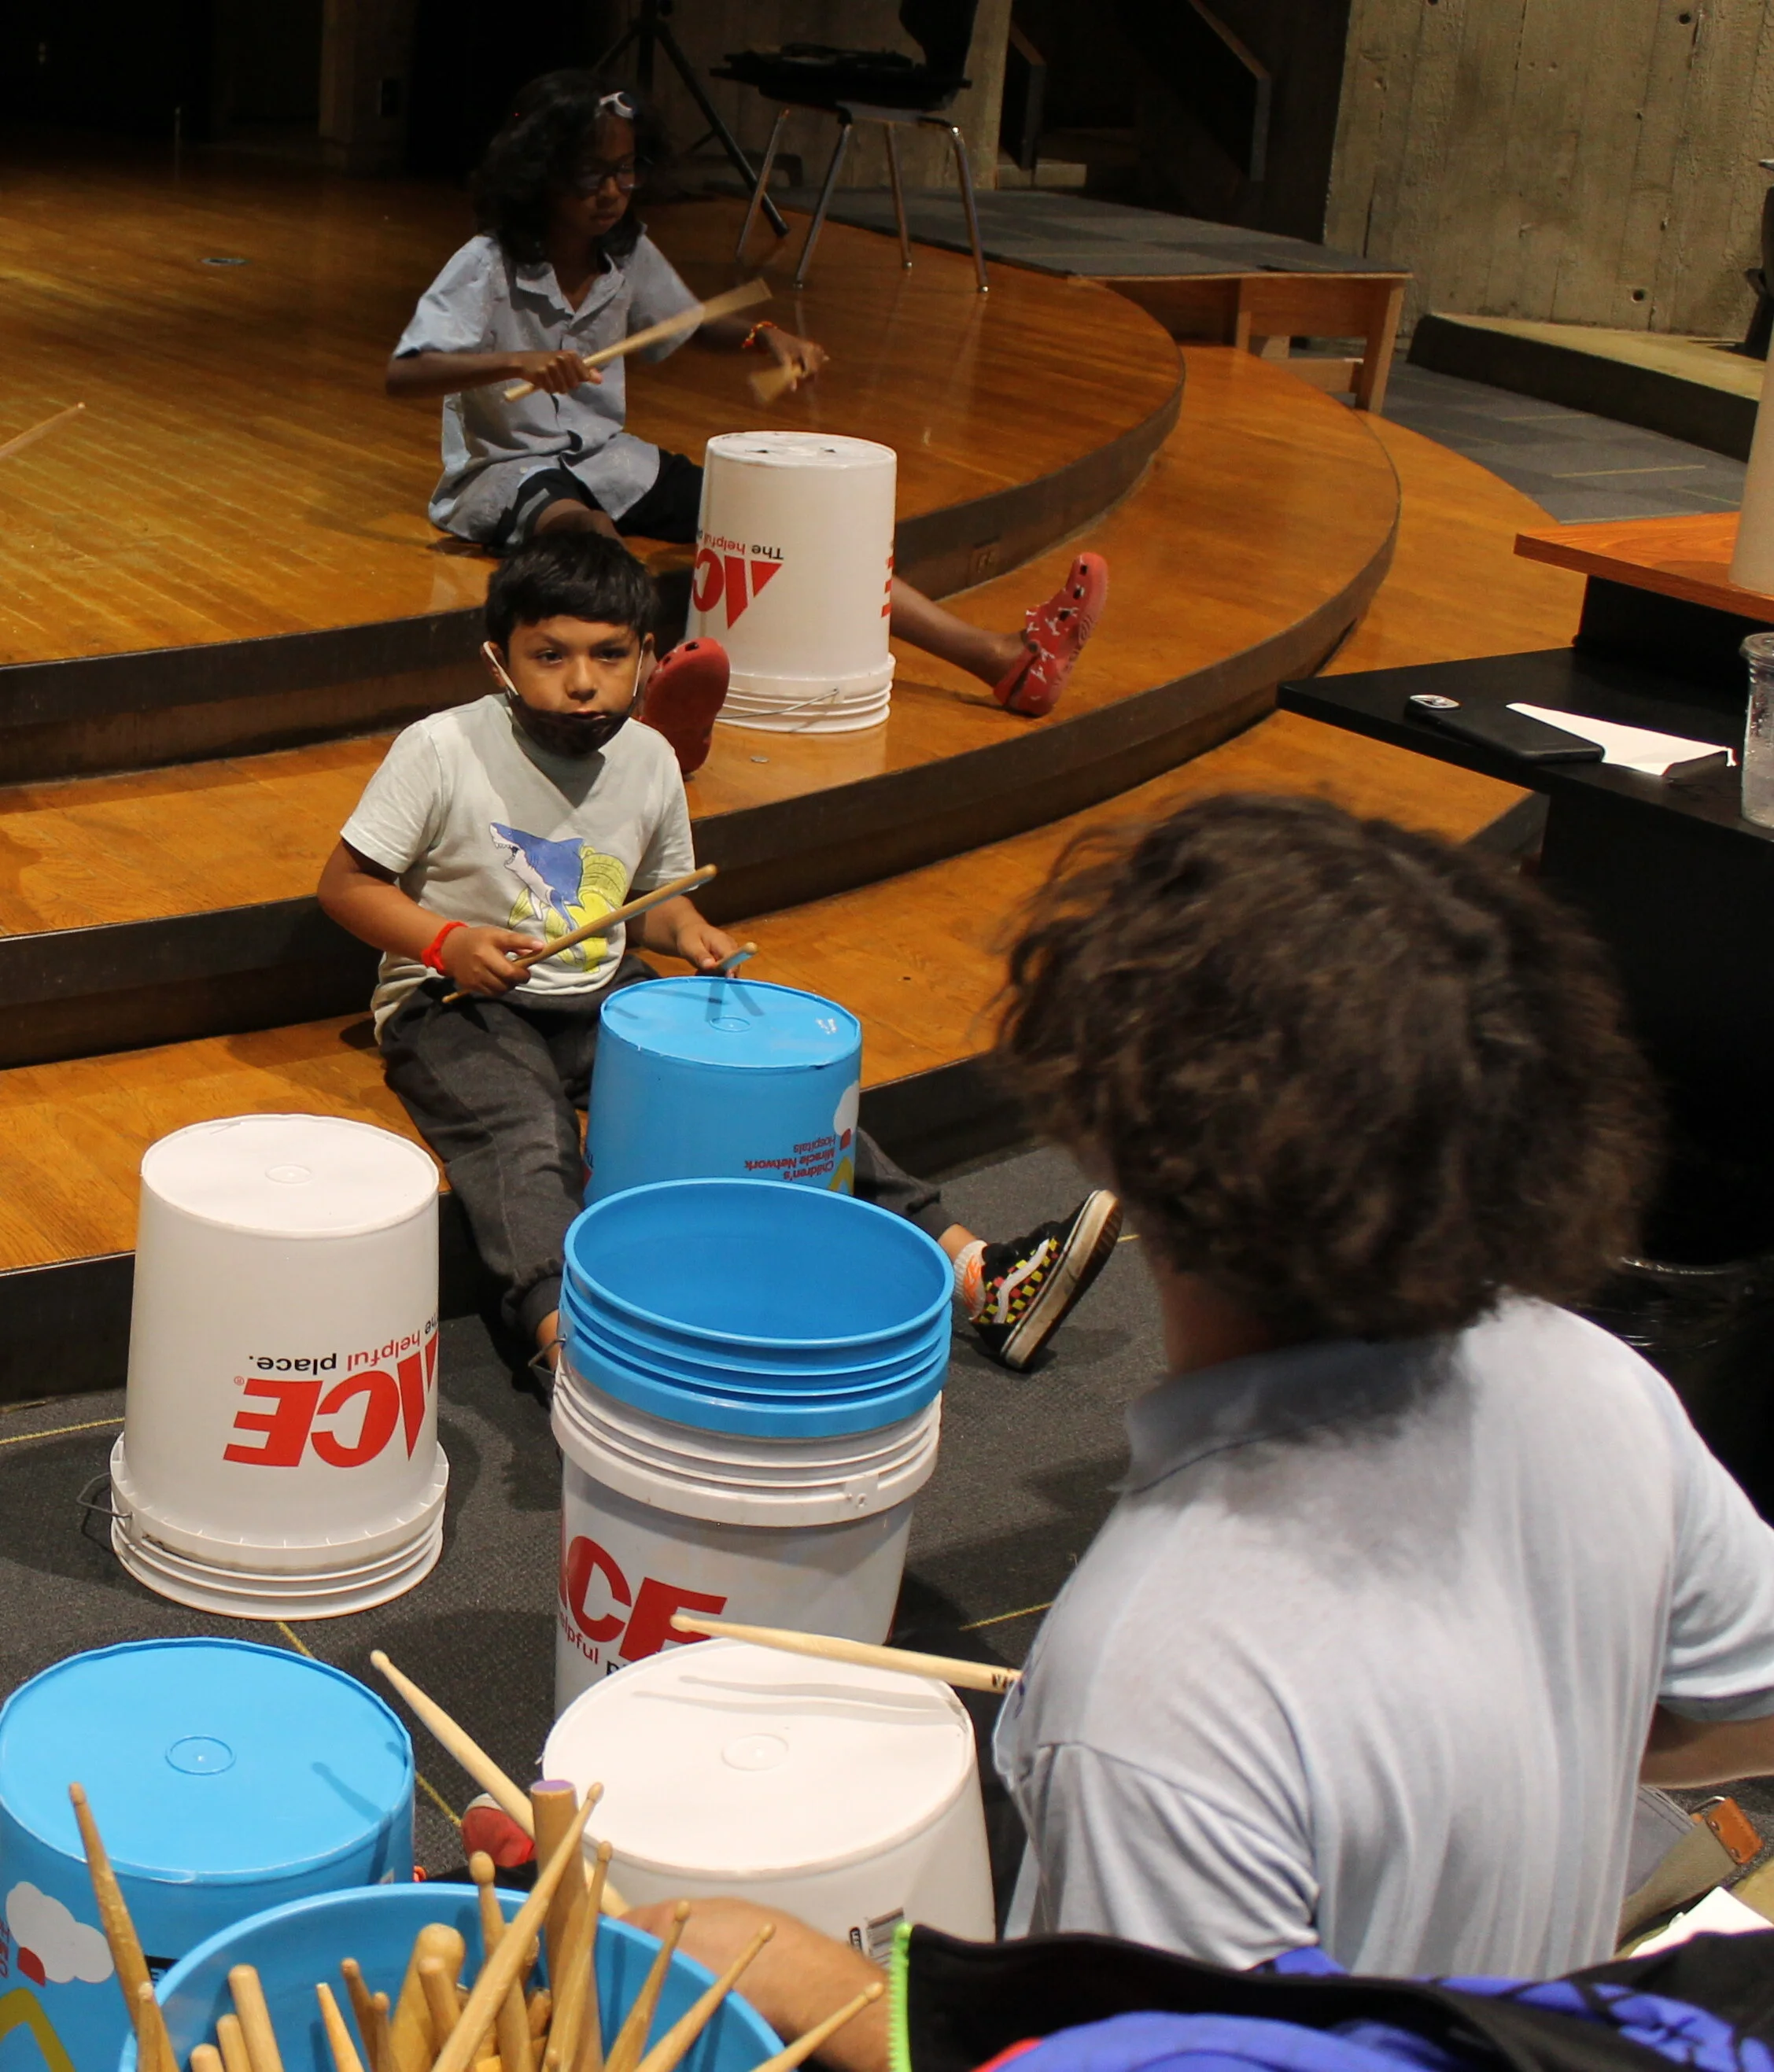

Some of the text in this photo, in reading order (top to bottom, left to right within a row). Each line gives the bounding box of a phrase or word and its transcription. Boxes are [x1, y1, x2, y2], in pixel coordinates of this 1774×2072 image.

[704, 533, 746, 555] helpful
[751, 544, 784, 560] The
[794, 1134, 835, 1153] Hospitals
[746, 1148, 835, 1171] Miracle Network
[784, 1161, 834, 1181] Children's
[249, 1313, 439, 1376] he helpful place.
[223, 1332, 438, 1468] ACE
[559, 1536, 728, 1662] CE
[559, 1609, 599, 1665] elpful
